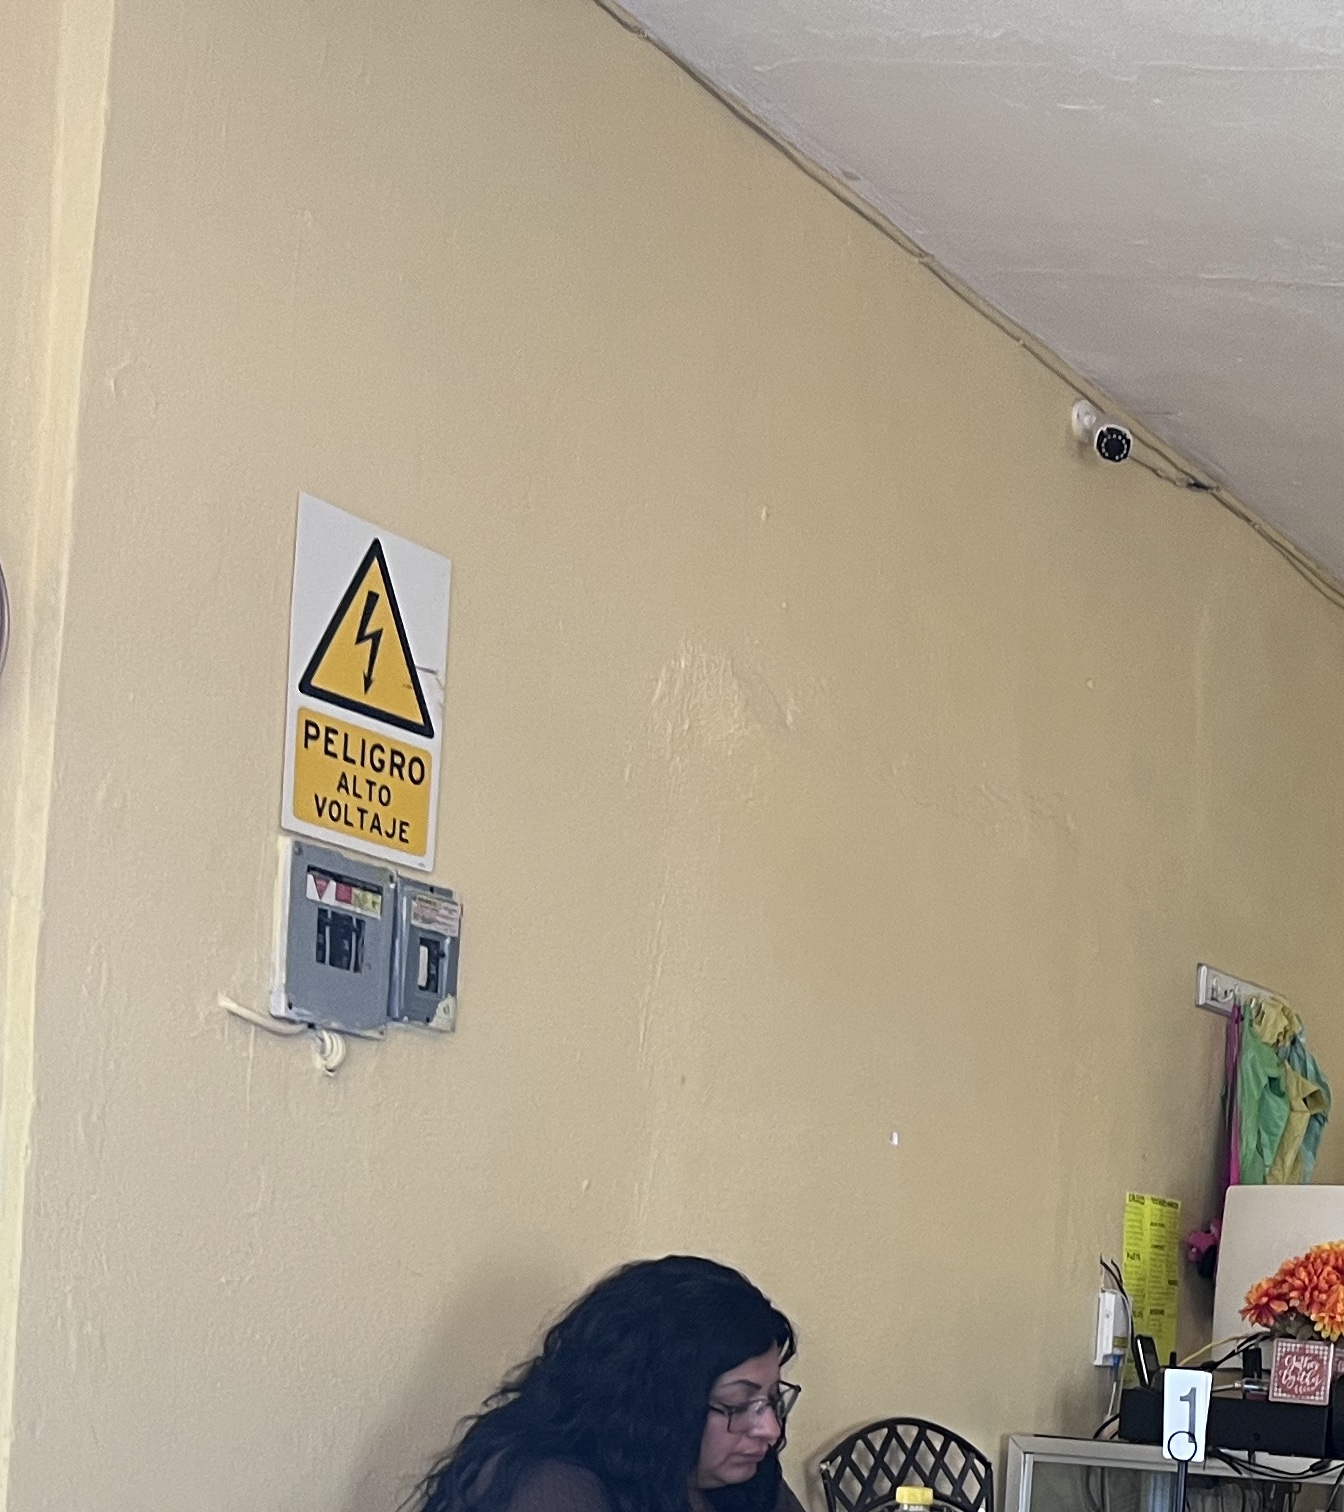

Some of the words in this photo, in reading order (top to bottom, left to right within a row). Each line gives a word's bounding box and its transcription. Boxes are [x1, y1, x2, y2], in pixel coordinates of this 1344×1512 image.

[302, 718, 427, 787] PELIGRO
[336, 771, 393, 808] ALTO
[313, 794, 411, 845] VOLTAJE
[1178, 1386, 1198, 1444] 1
